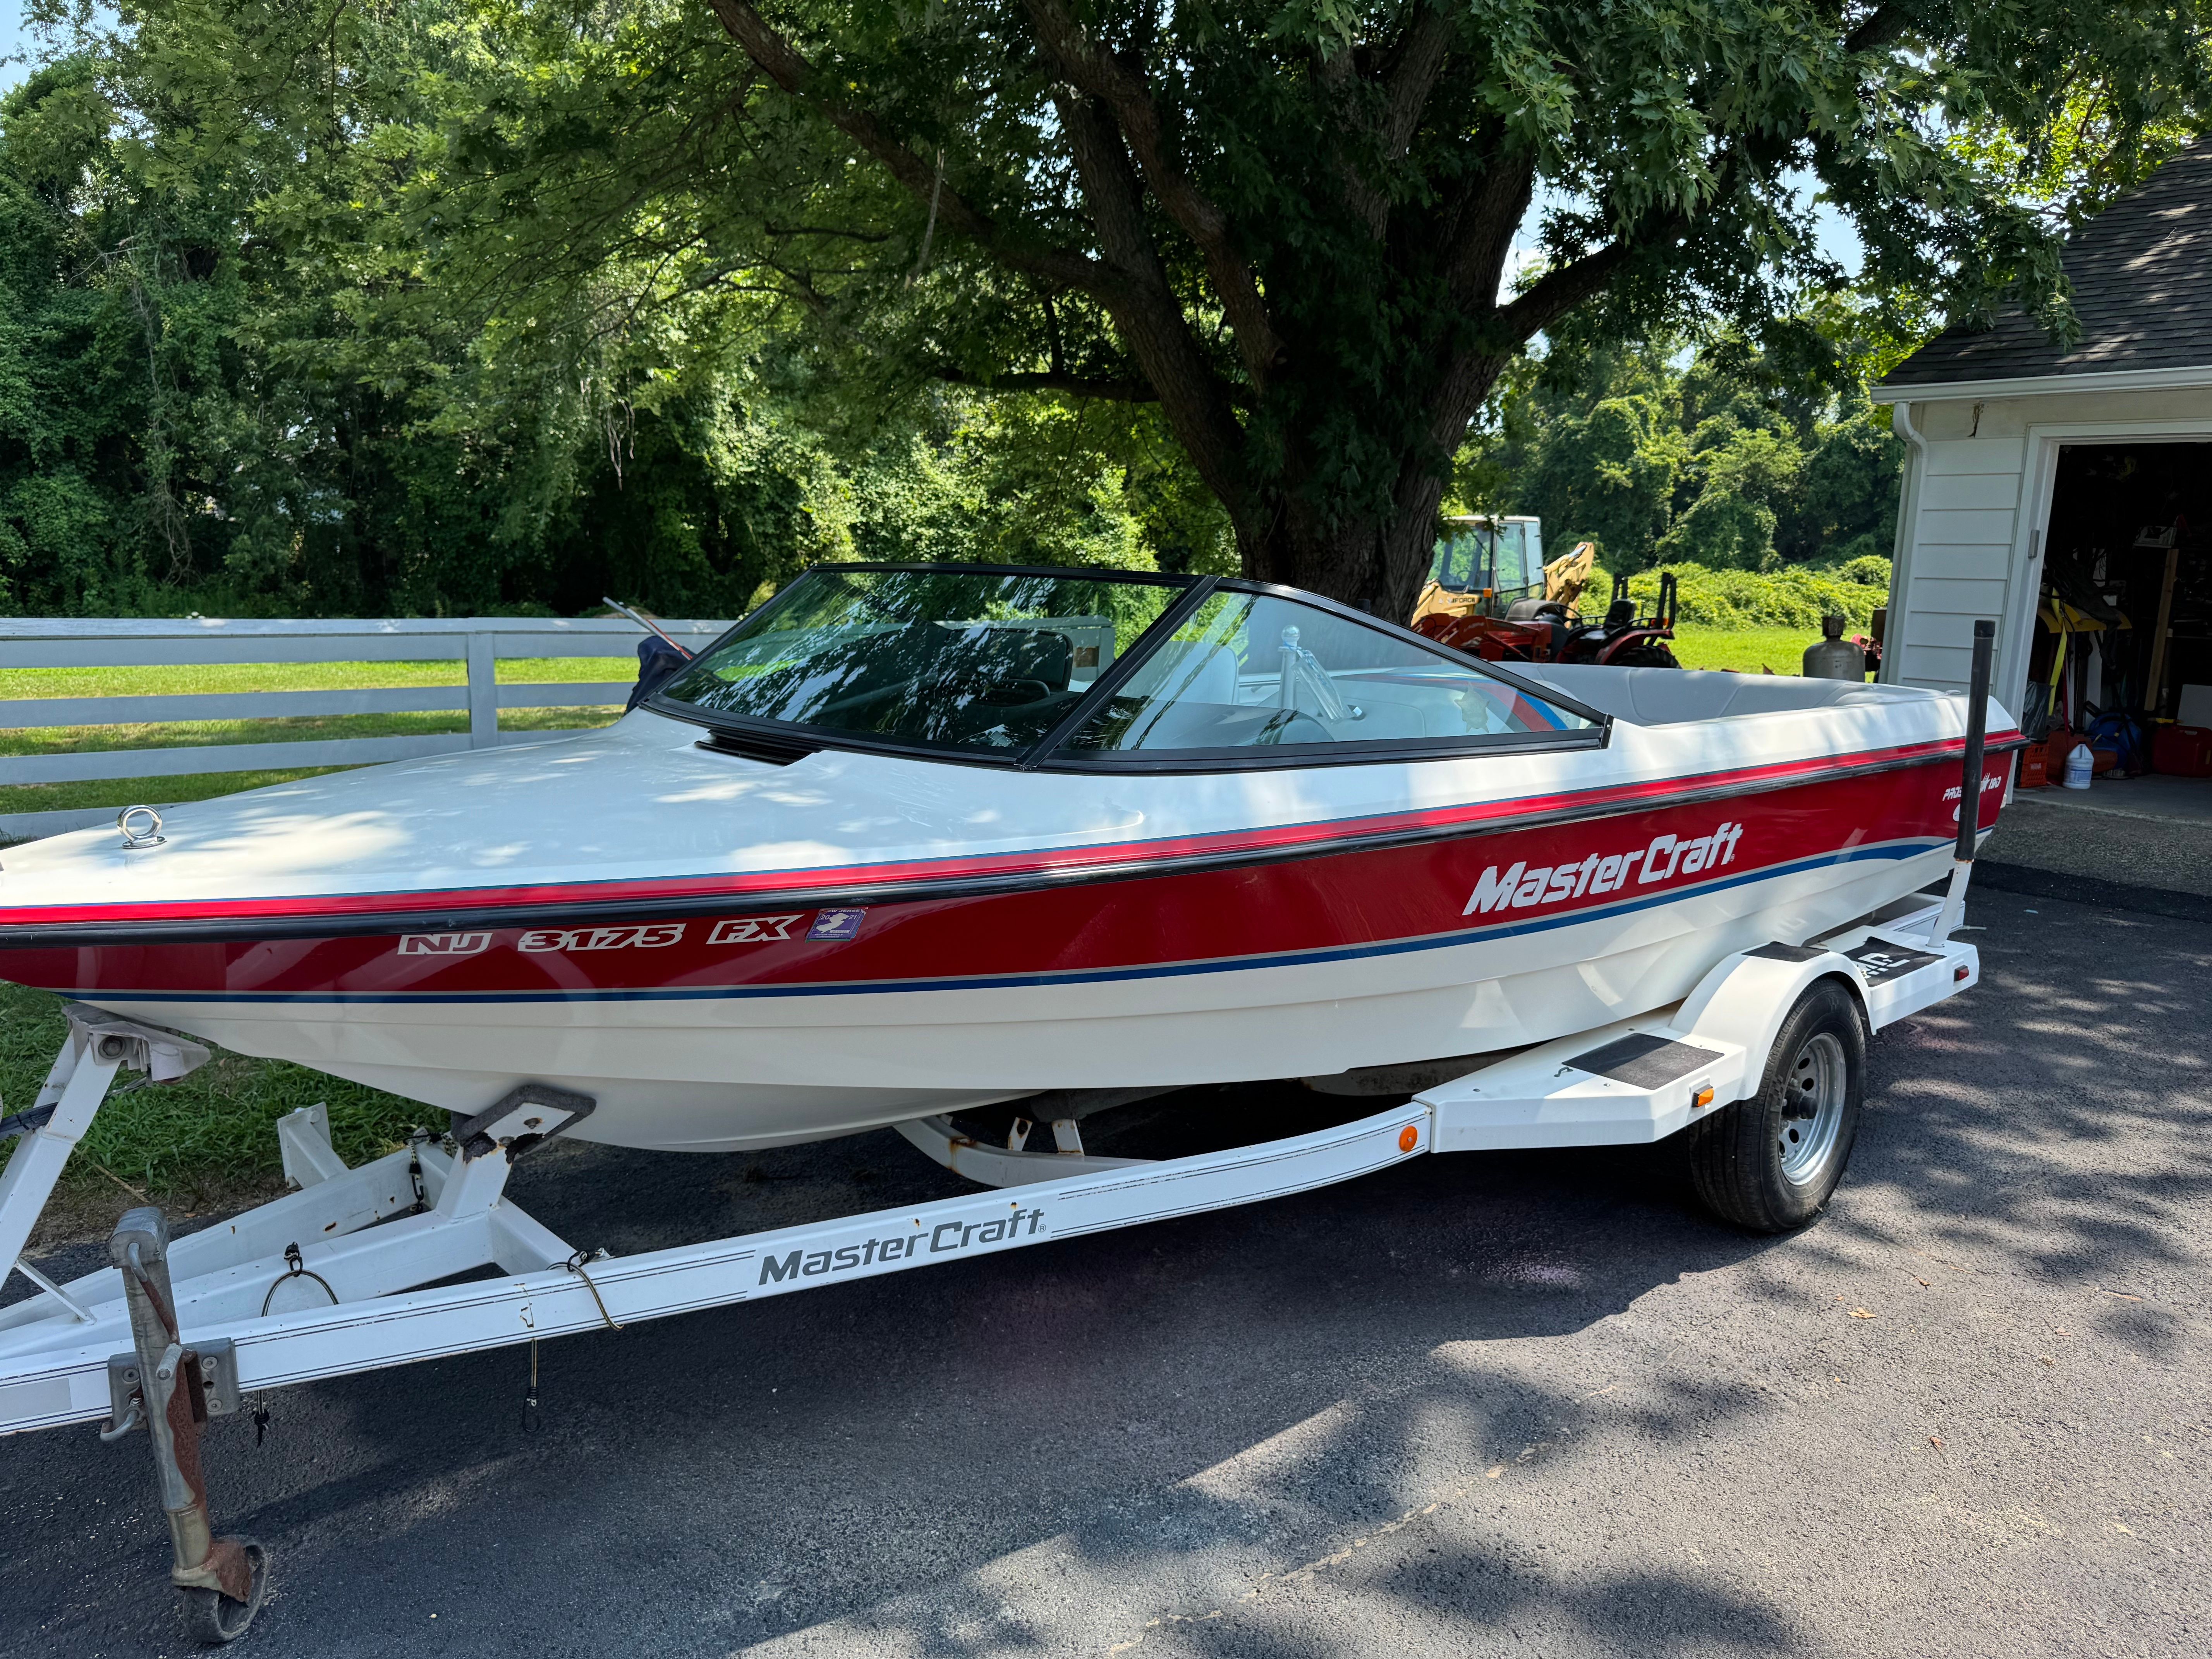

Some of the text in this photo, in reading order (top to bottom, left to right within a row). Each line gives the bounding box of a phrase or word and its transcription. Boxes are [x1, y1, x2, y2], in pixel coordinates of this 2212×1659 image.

[397, 914, 805, 955] NJ 3175 FX
